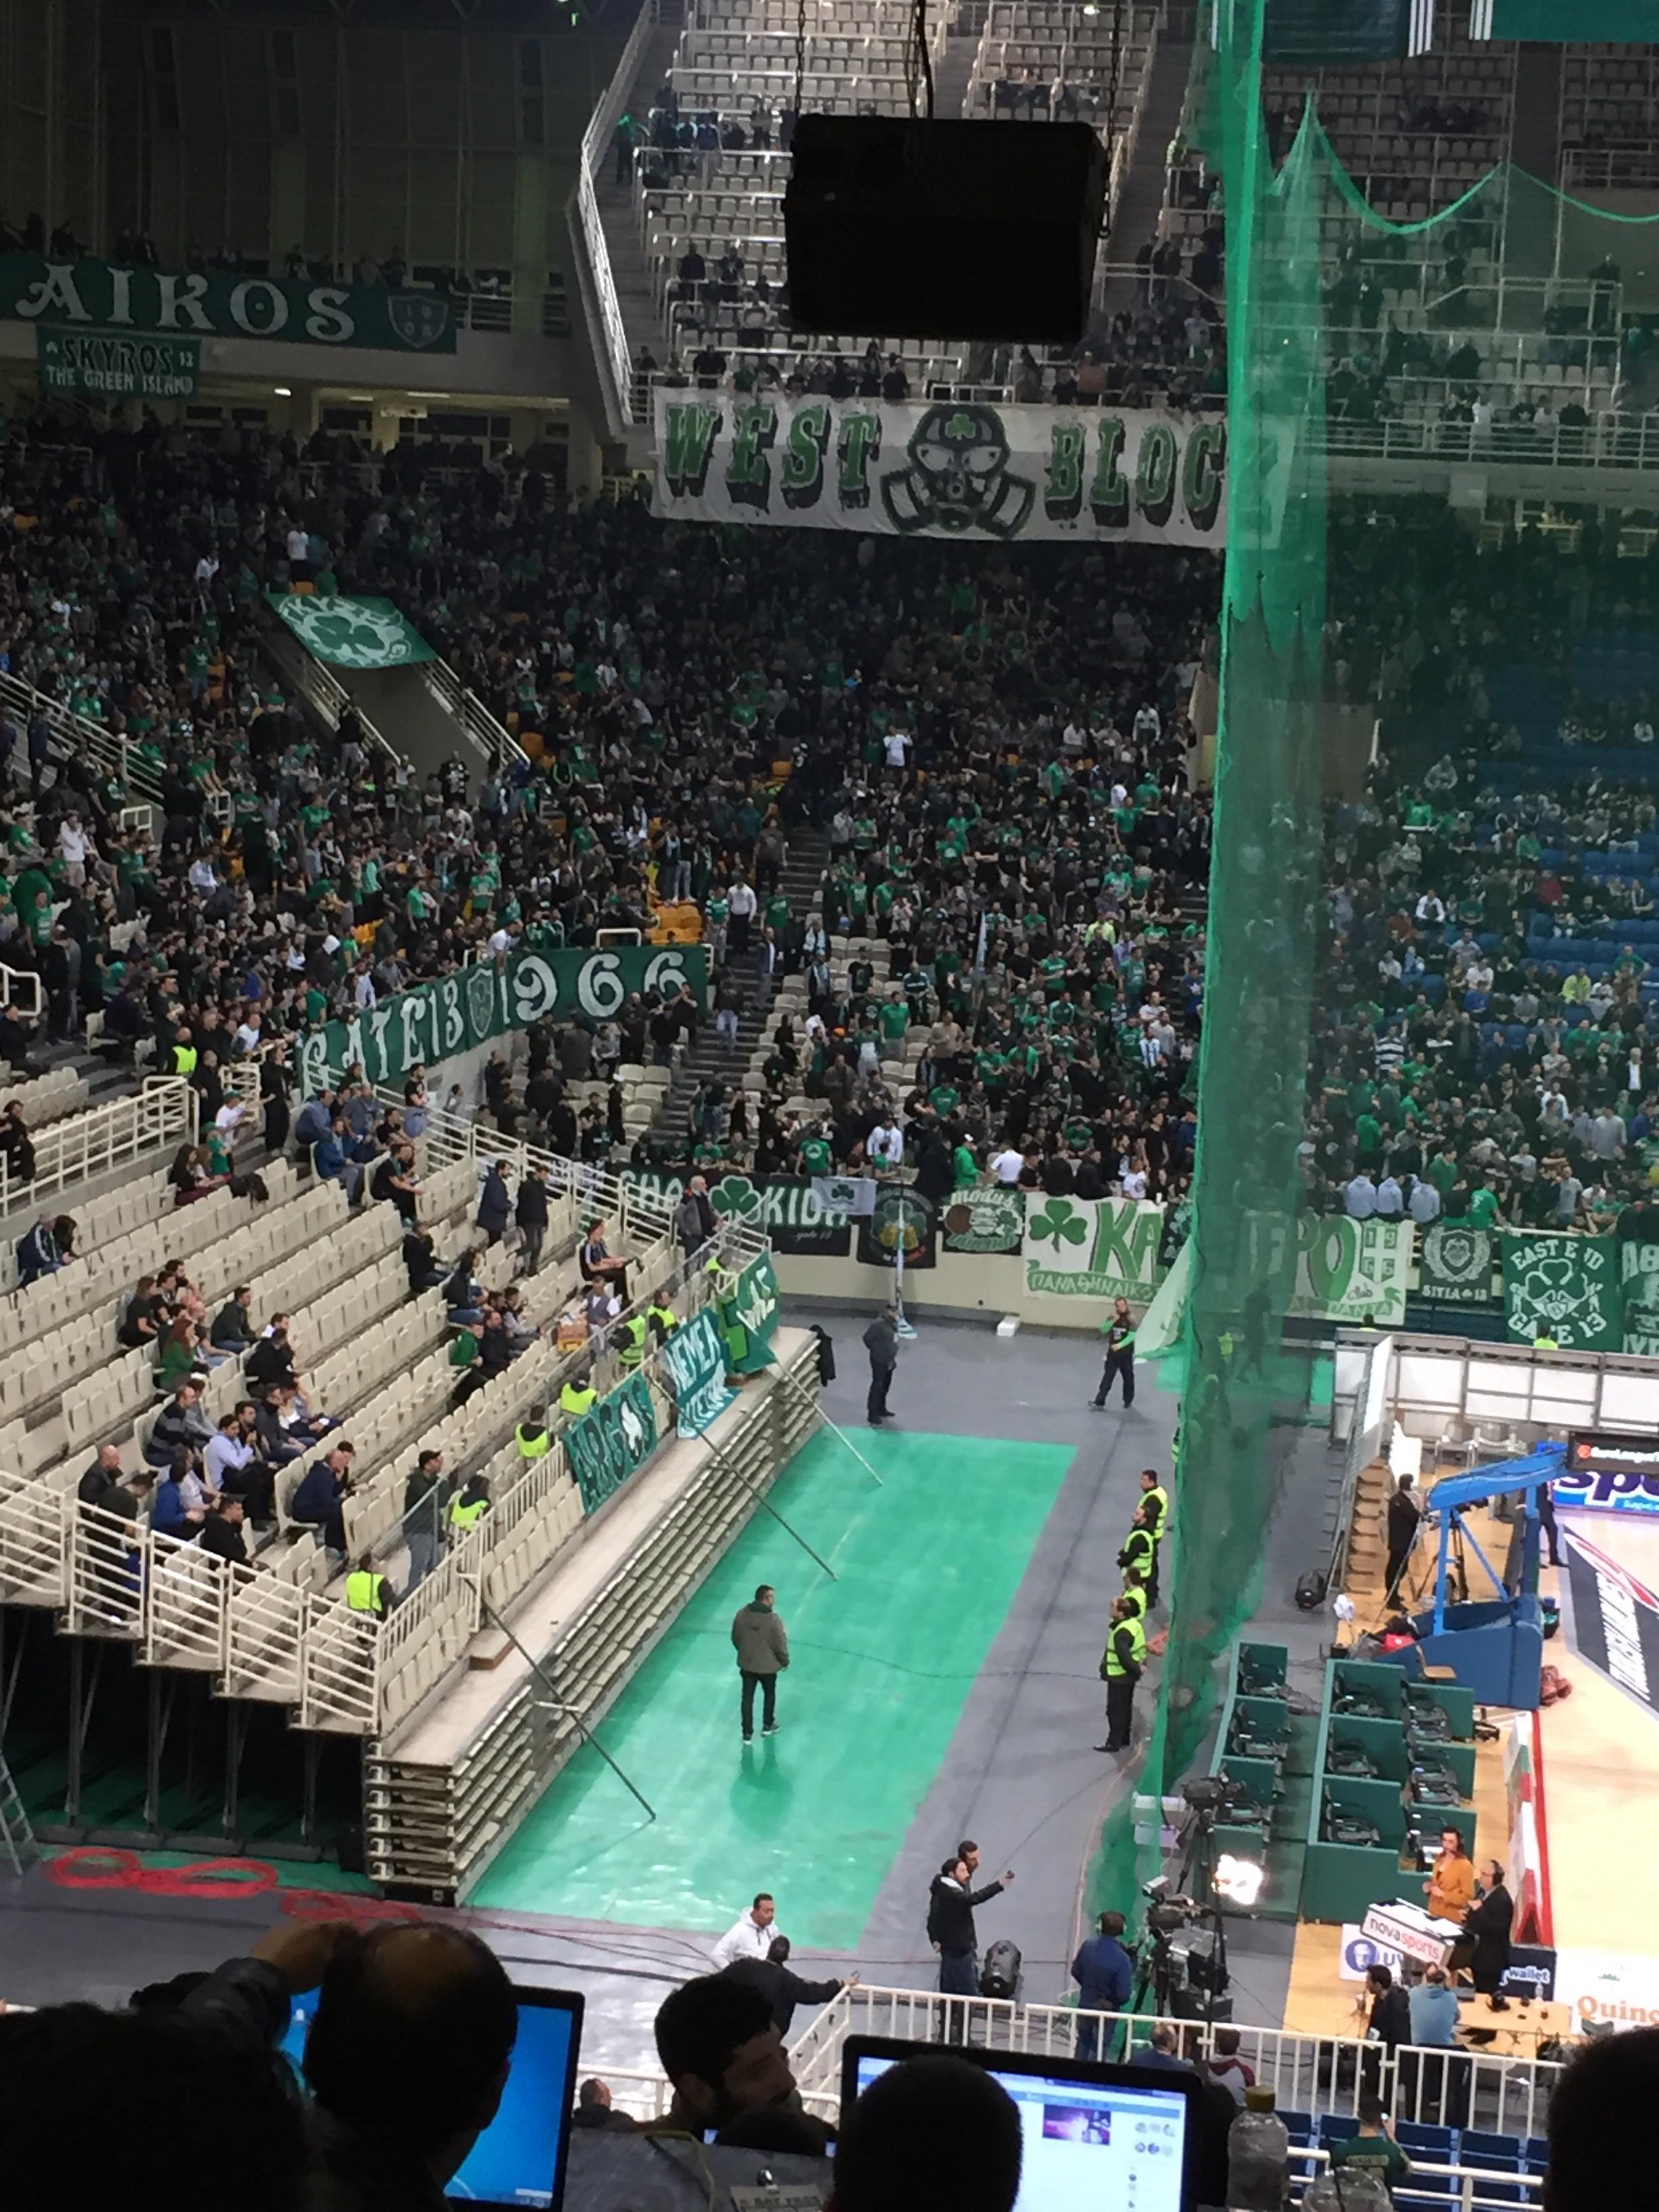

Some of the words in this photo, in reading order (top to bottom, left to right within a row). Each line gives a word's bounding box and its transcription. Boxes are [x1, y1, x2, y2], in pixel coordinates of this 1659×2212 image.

[63, 337, 173, 375] SKYROS
[45, 365, 77, 386] THE
[84, 370, 134, 391] GREEN
[142, 374, 194, 395] ISLAND
[664, 401, 882, 513] WEST
[1044, 416, 1229, 533] BLOC
[501, 950, 687, 1025] 1966
[1511, 1239, 1559, 1271] EAST
[1508, 1312, 1574, 1345] GAE
[1578, 1312, 1607, 1338] 13
[1370, 1918, 1439, 1960] novasports
